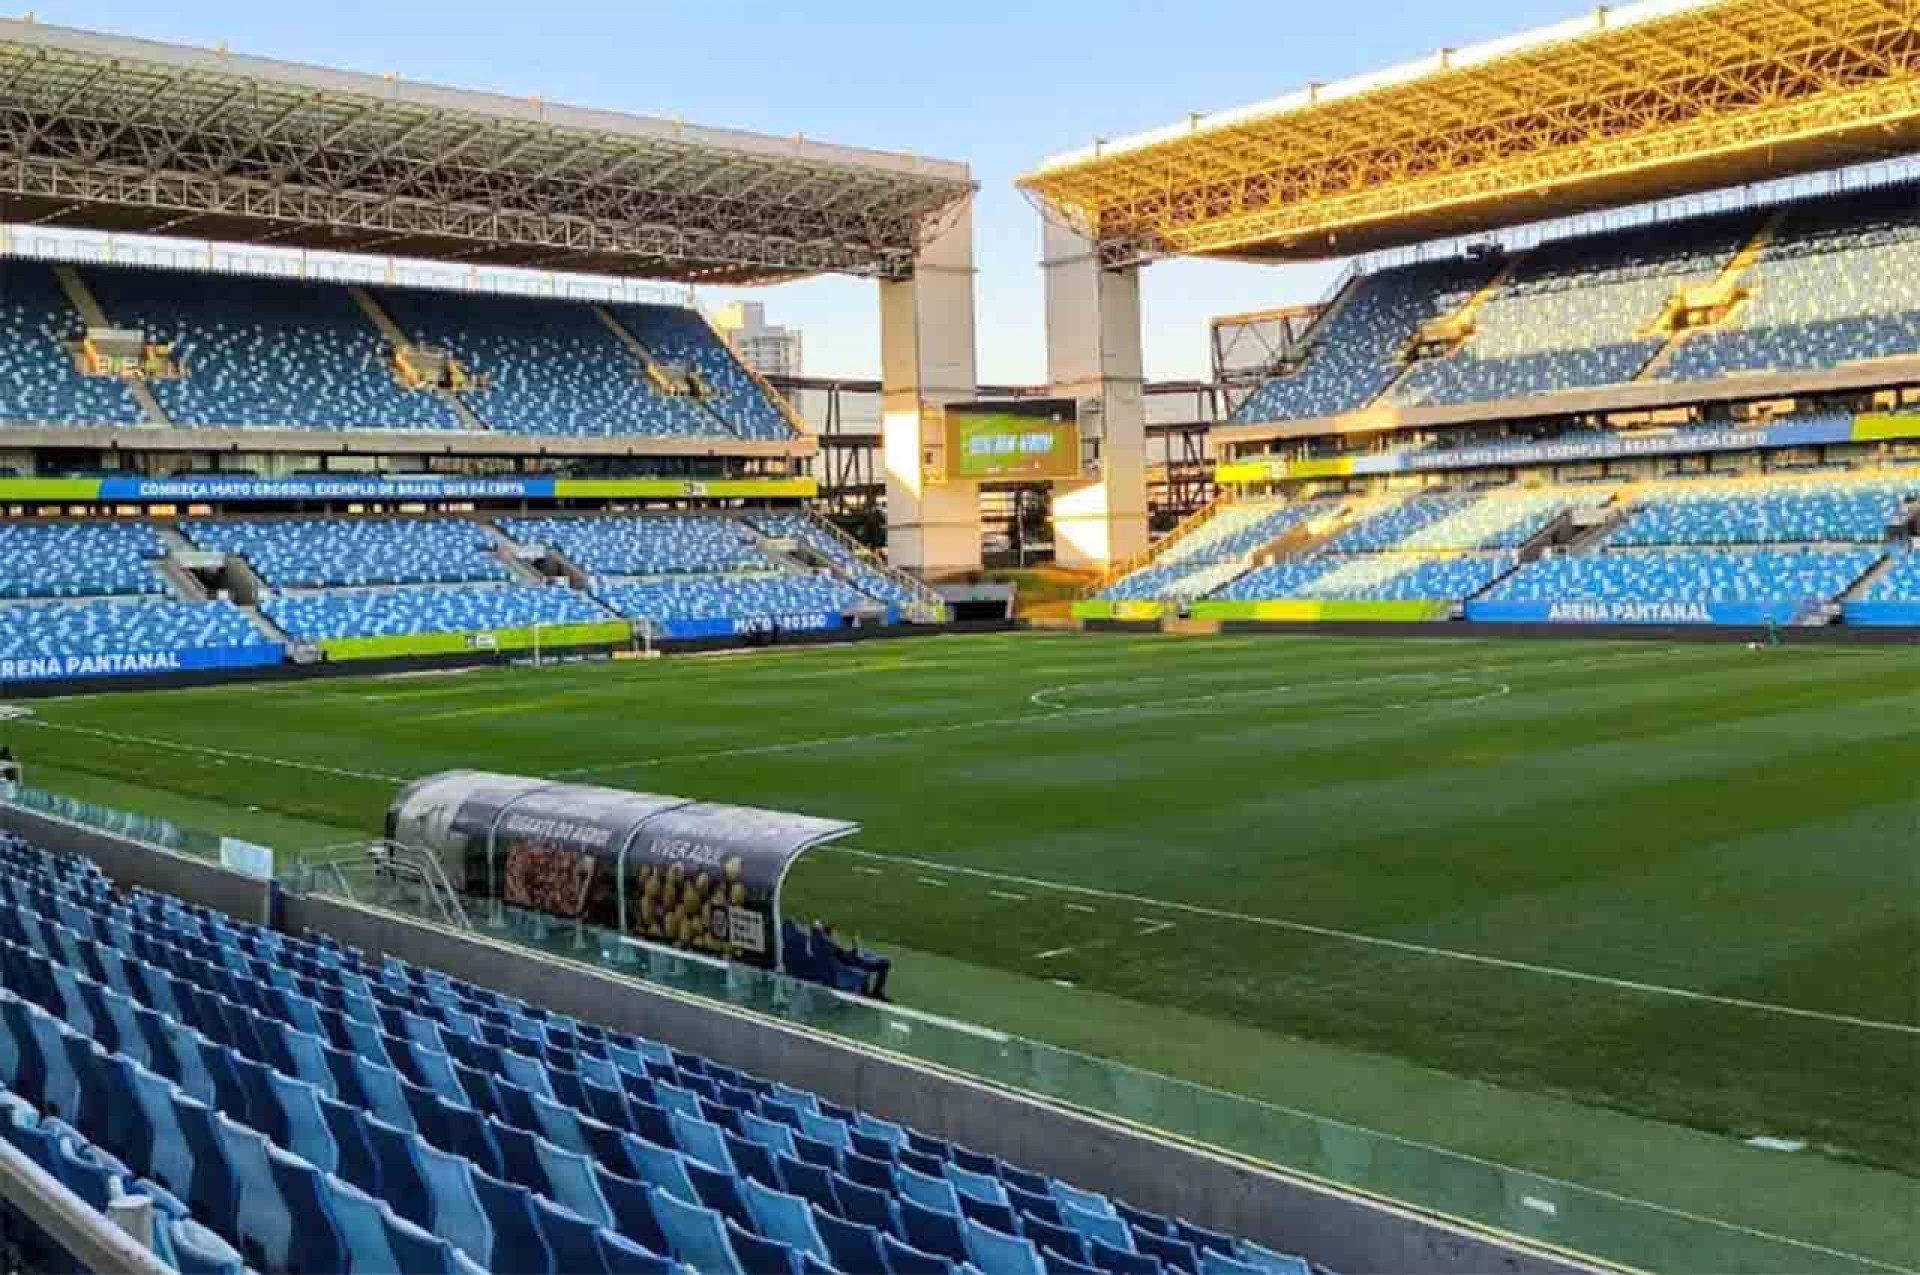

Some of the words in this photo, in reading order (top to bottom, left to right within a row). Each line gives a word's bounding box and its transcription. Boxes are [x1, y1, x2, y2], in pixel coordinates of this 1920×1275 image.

[1722, 431, 1768, 445] CERTO
[140, 481, 207, 498] CONHEÇA
[210, 482, 250, 496] MATO
[315, 482, 375, 496] EXEMPLO
[378, 482, 395, 496] DE
[441, 482, 468, 497] QUE
[1548, 602, 1608, 622] ARENA
[1611, 602, 1713, 622] PANTANAL
[0, 656, 61, 680] RENA
[65, 651, 181, 673] PANTANAL
